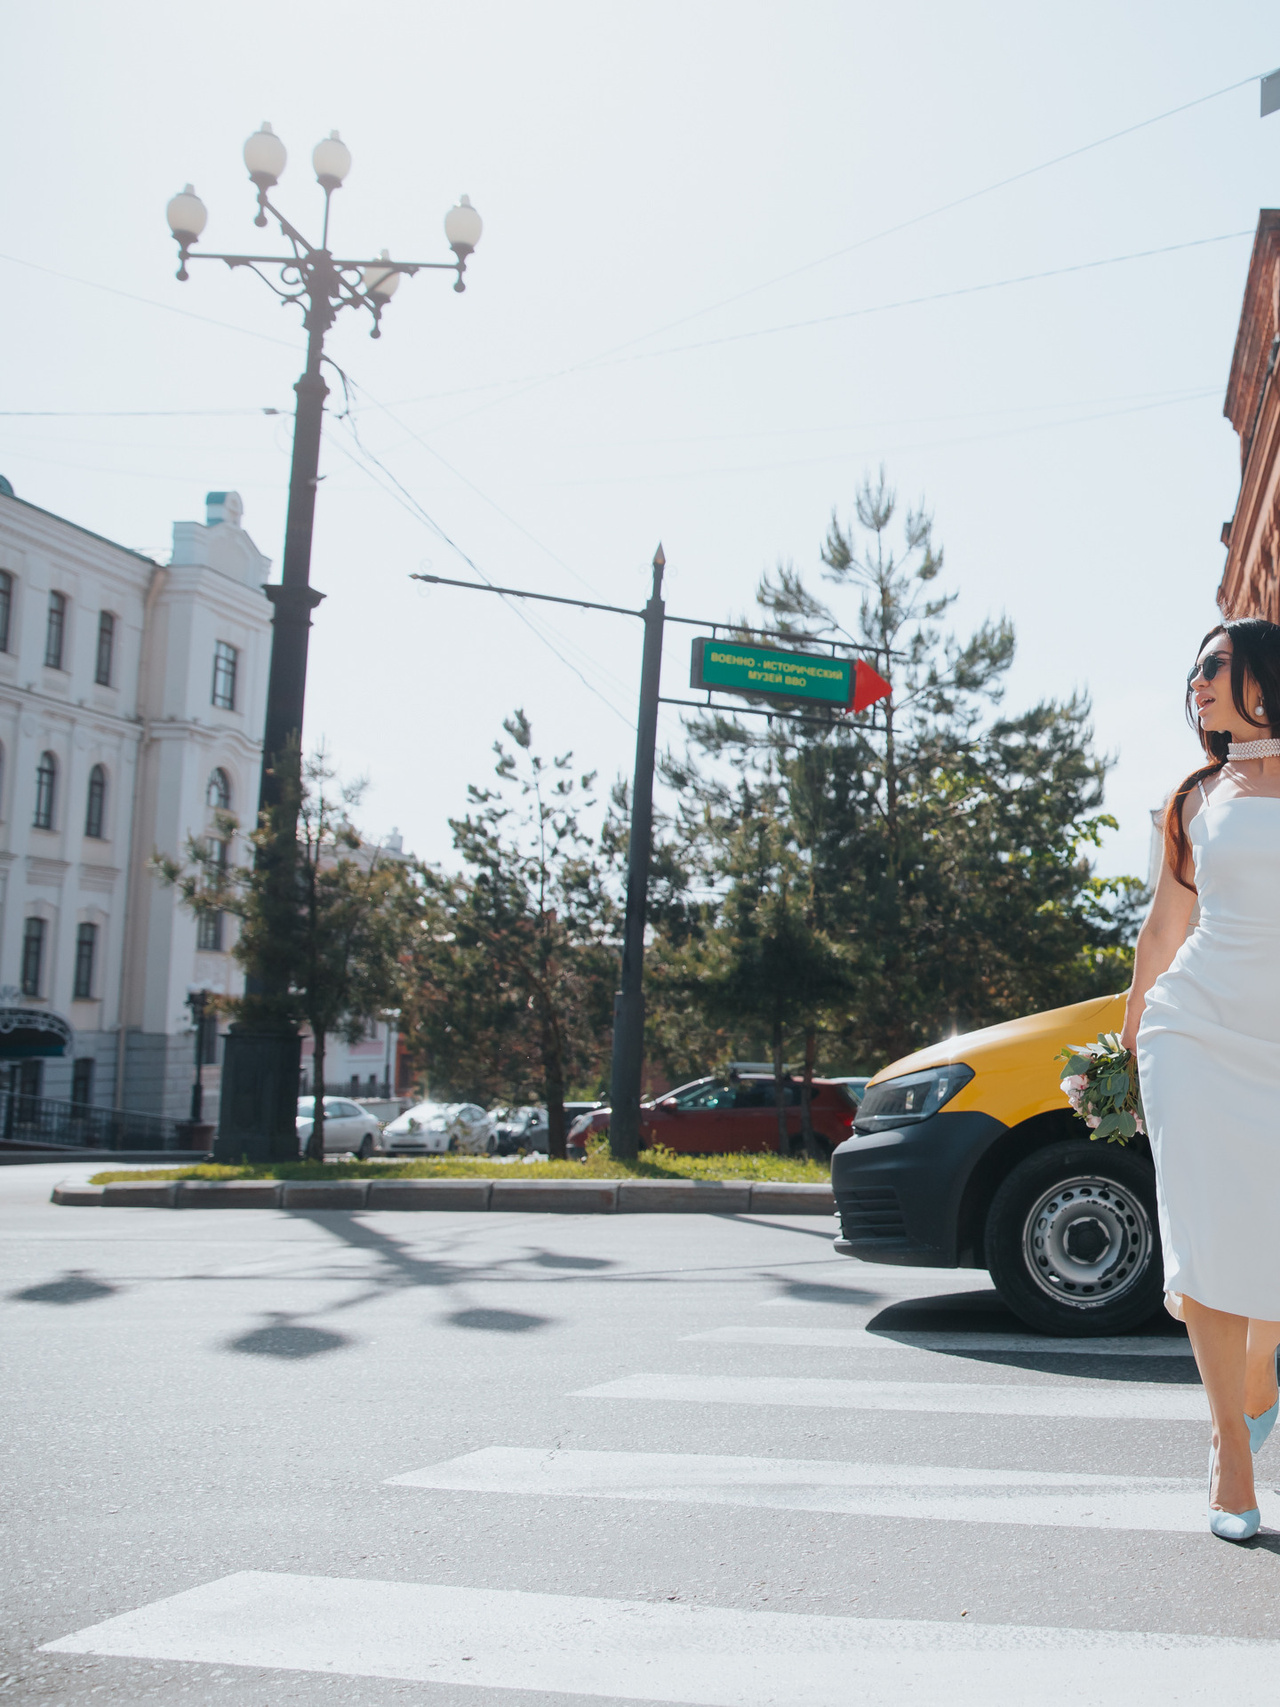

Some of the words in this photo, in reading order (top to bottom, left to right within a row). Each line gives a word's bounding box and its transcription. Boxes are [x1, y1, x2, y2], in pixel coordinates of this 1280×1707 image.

[711, 652, 755, 668] ВОЕННО
[763, 660, 843, 680] ИСТОРИЧЕСКИЙ
[748, 670, 783, 683] МУЗЕЙ
[784, 675, 807, 687] ВВО
